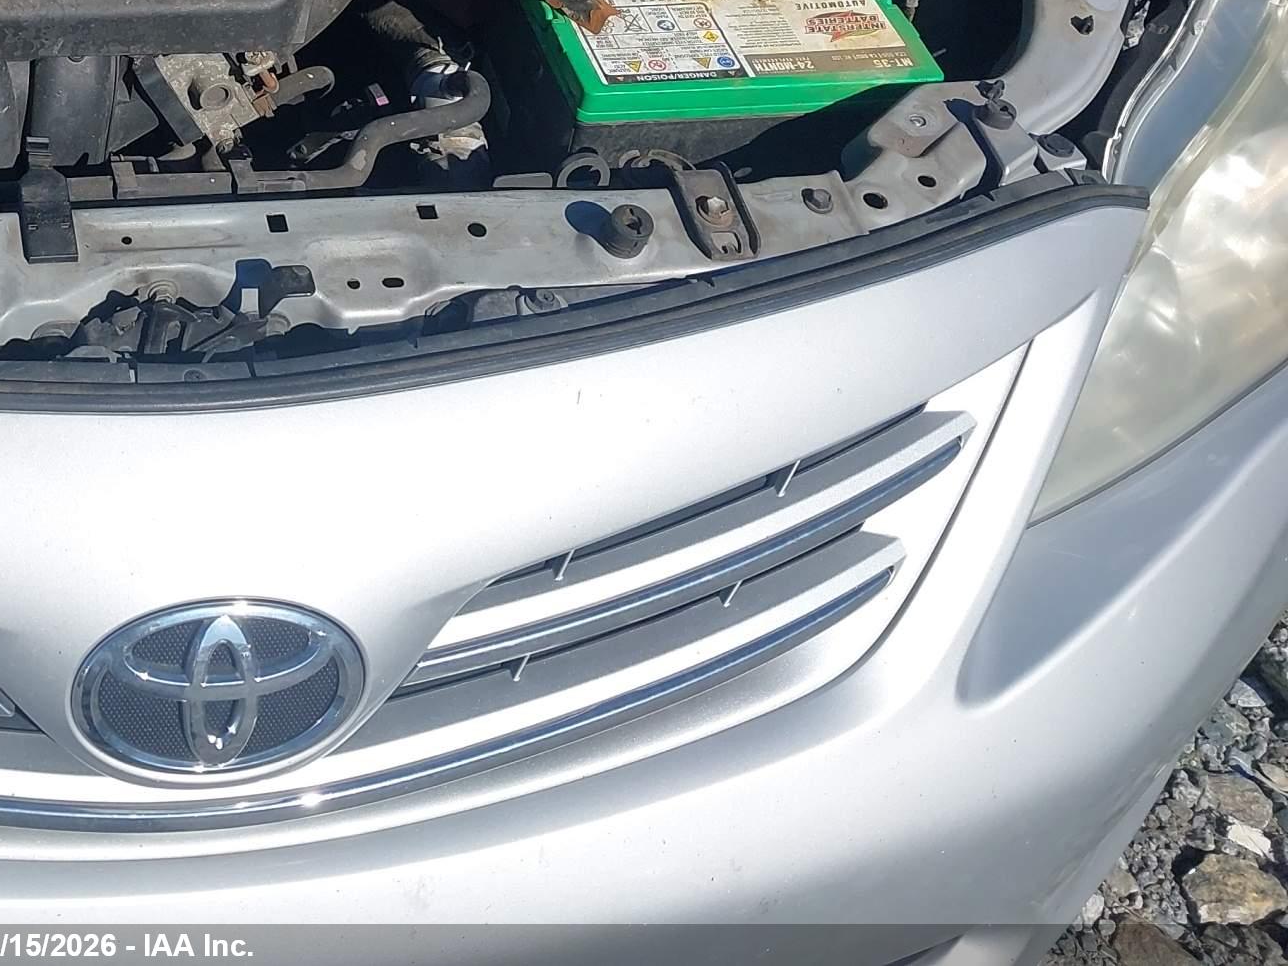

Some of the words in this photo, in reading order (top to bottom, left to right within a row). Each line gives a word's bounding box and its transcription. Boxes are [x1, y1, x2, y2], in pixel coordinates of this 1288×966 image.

[795, 0, 866, 11] AUTOMOTIVE
[806, 15, 879, 26] BATTERIES
[808, 21, 886, 34] INTERSTATE
[754, 60, 815, 72] 24-MONTH
[873, 57, 914, 68] MT-35
[637, 71, 718, 81] DANGER/POISON
